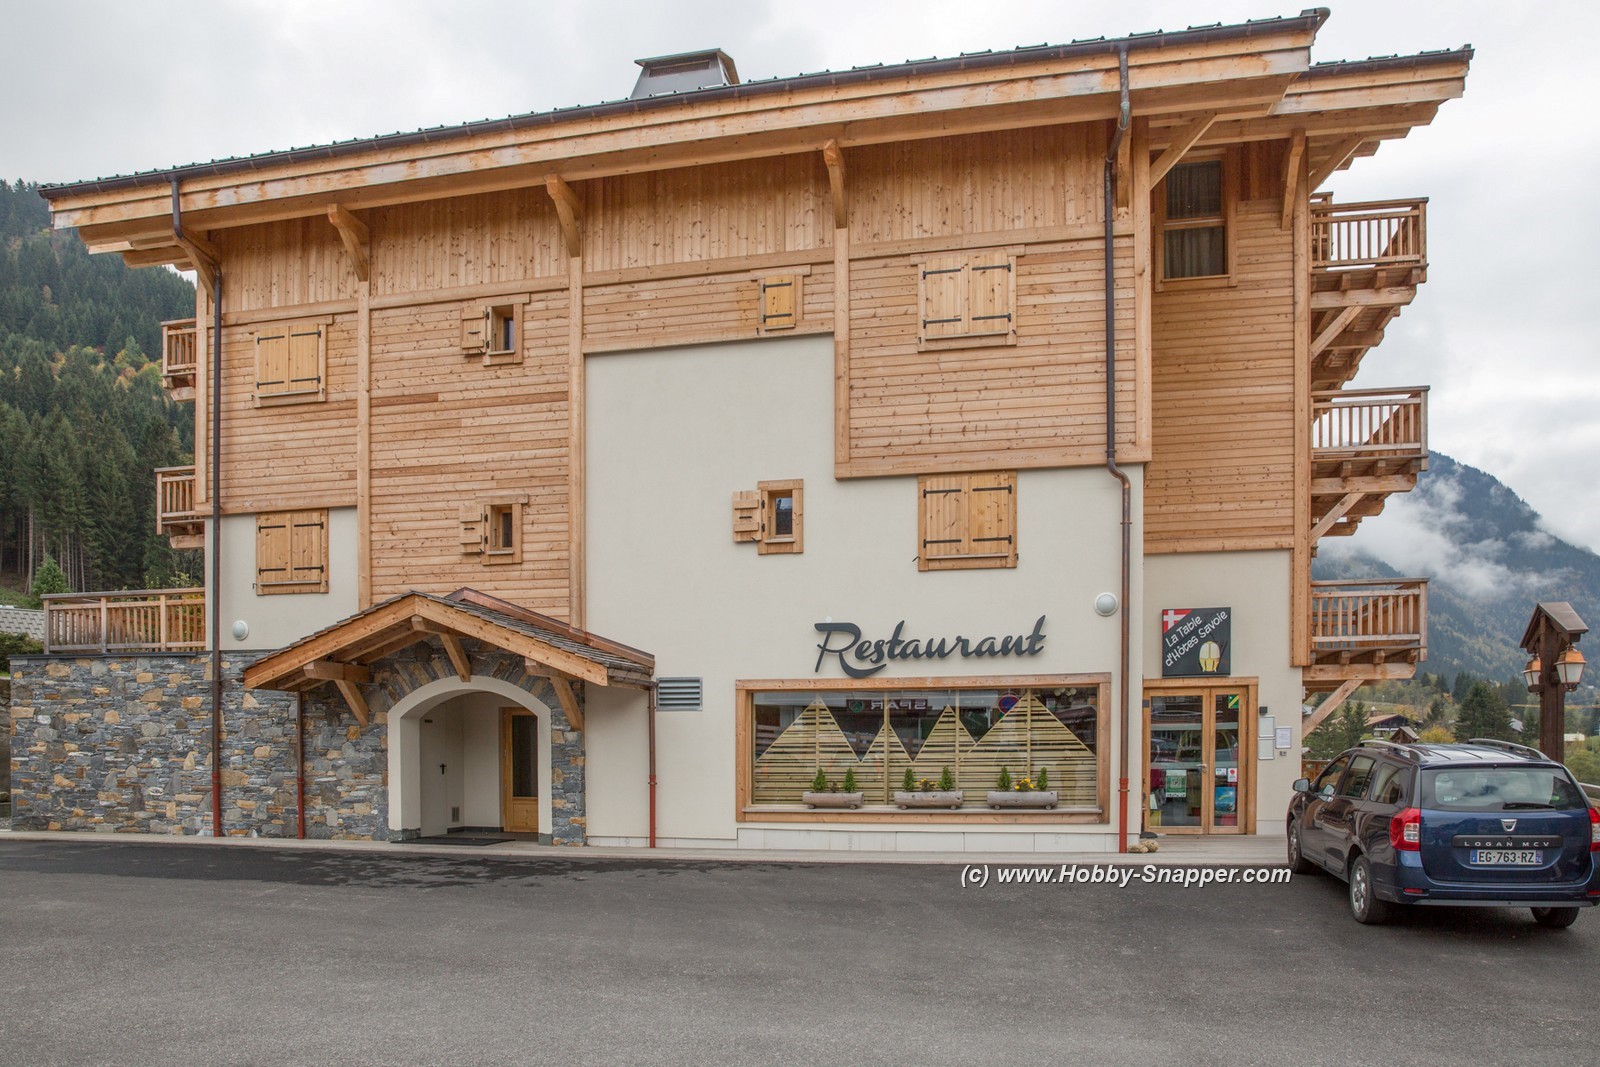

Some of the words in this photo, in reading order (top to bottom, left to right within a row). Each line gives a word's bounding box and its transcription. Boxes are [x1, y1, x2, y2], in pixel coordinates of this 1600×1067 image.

[1165, 634, 1179, 647] La
[1176, 616, 1203, 637] Table
[1198, 611, 1228, 638] Savoie
[814, 615, 1047, 678] Restaurant
[1478, 851, 1534, 863] EG-763-RZ
